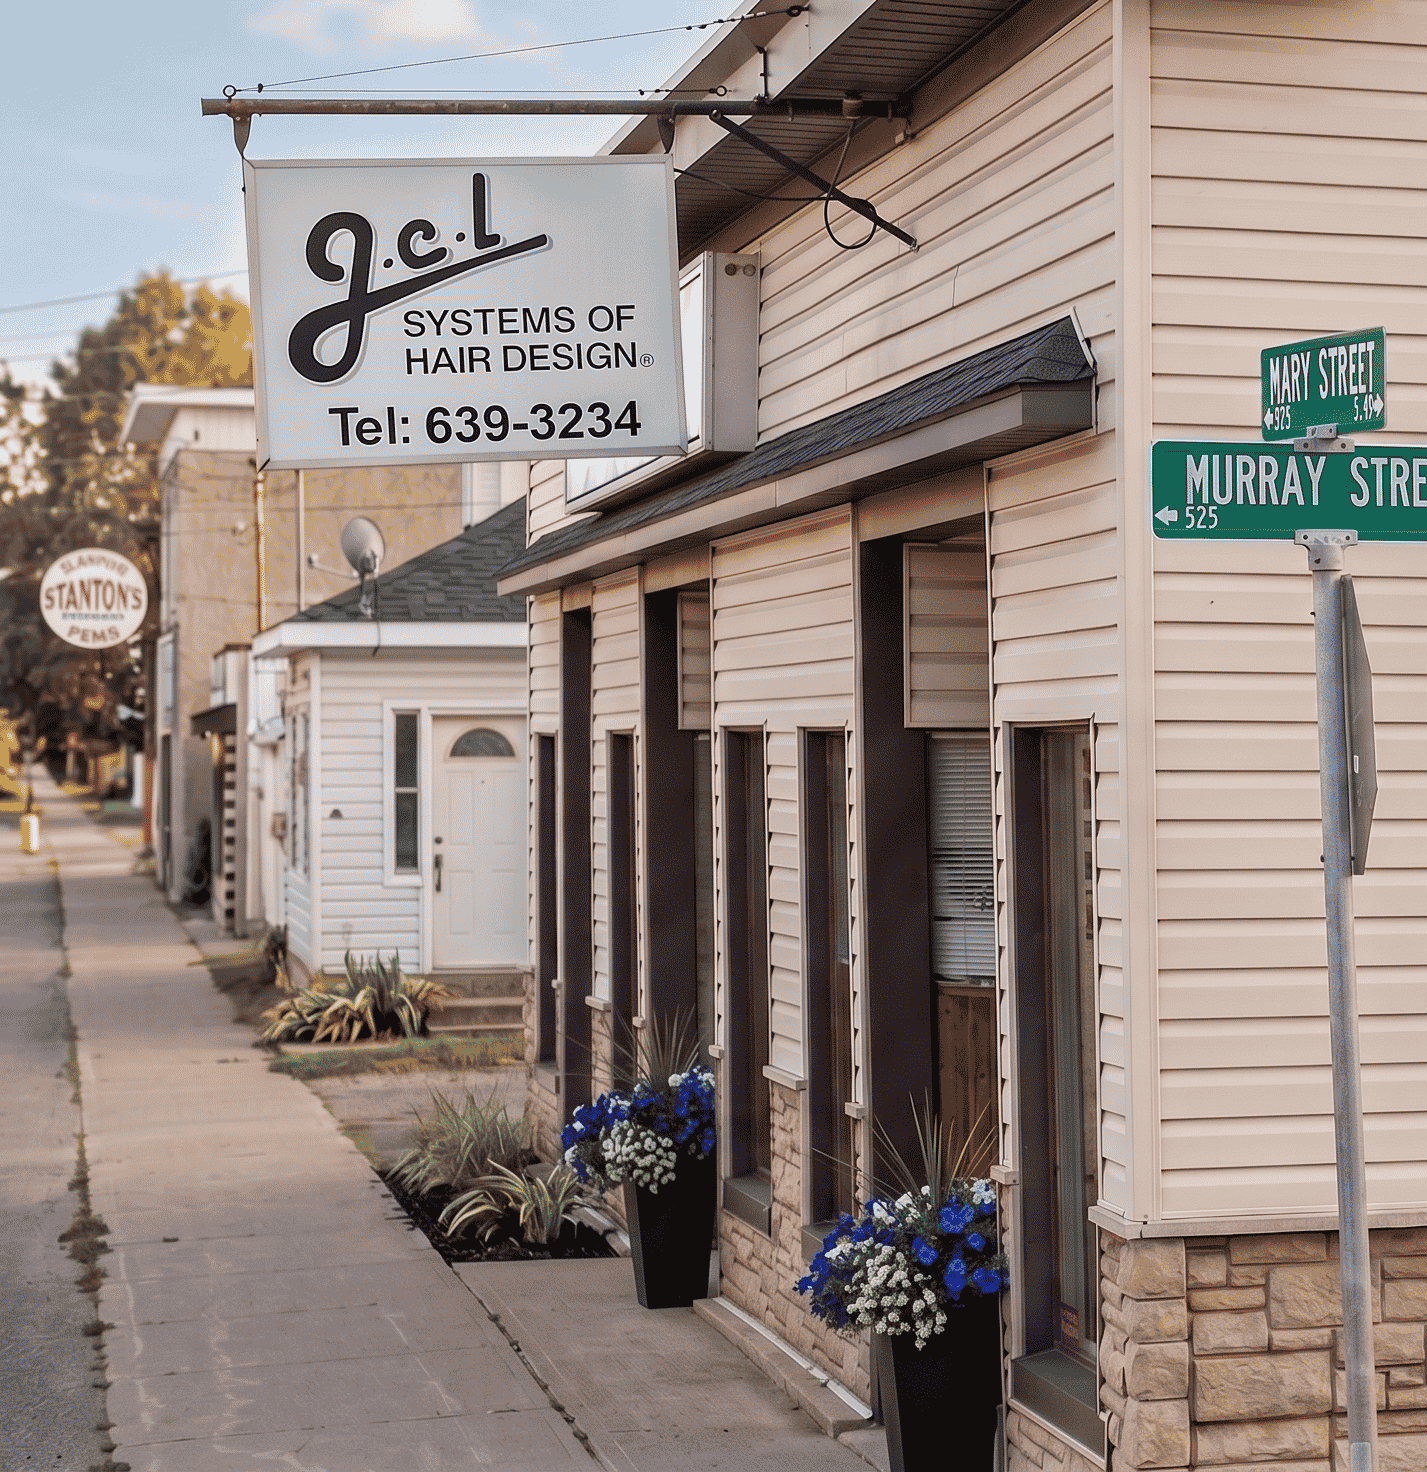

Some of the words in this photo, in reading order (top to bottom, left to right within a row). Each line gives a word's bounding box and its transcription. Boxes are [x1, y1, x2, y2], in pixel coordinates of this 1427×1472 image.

[403, 306, 576, 338] SYSTEMS
[587, 304, 637, 333] OF
[405, 346, 492, 375] HAIR
[1269, 351, 1311, 406] MARY
[1318, 340, 1375, 400] STREET
[328, 405, 411, 447] Tel:
[425, 400, 642, 444] 639-3234
[1274, 405, 1291, 431] 925
[1186, 454, 1327, 506] MURRAY
[1185, 505, 1218, 530] 525
